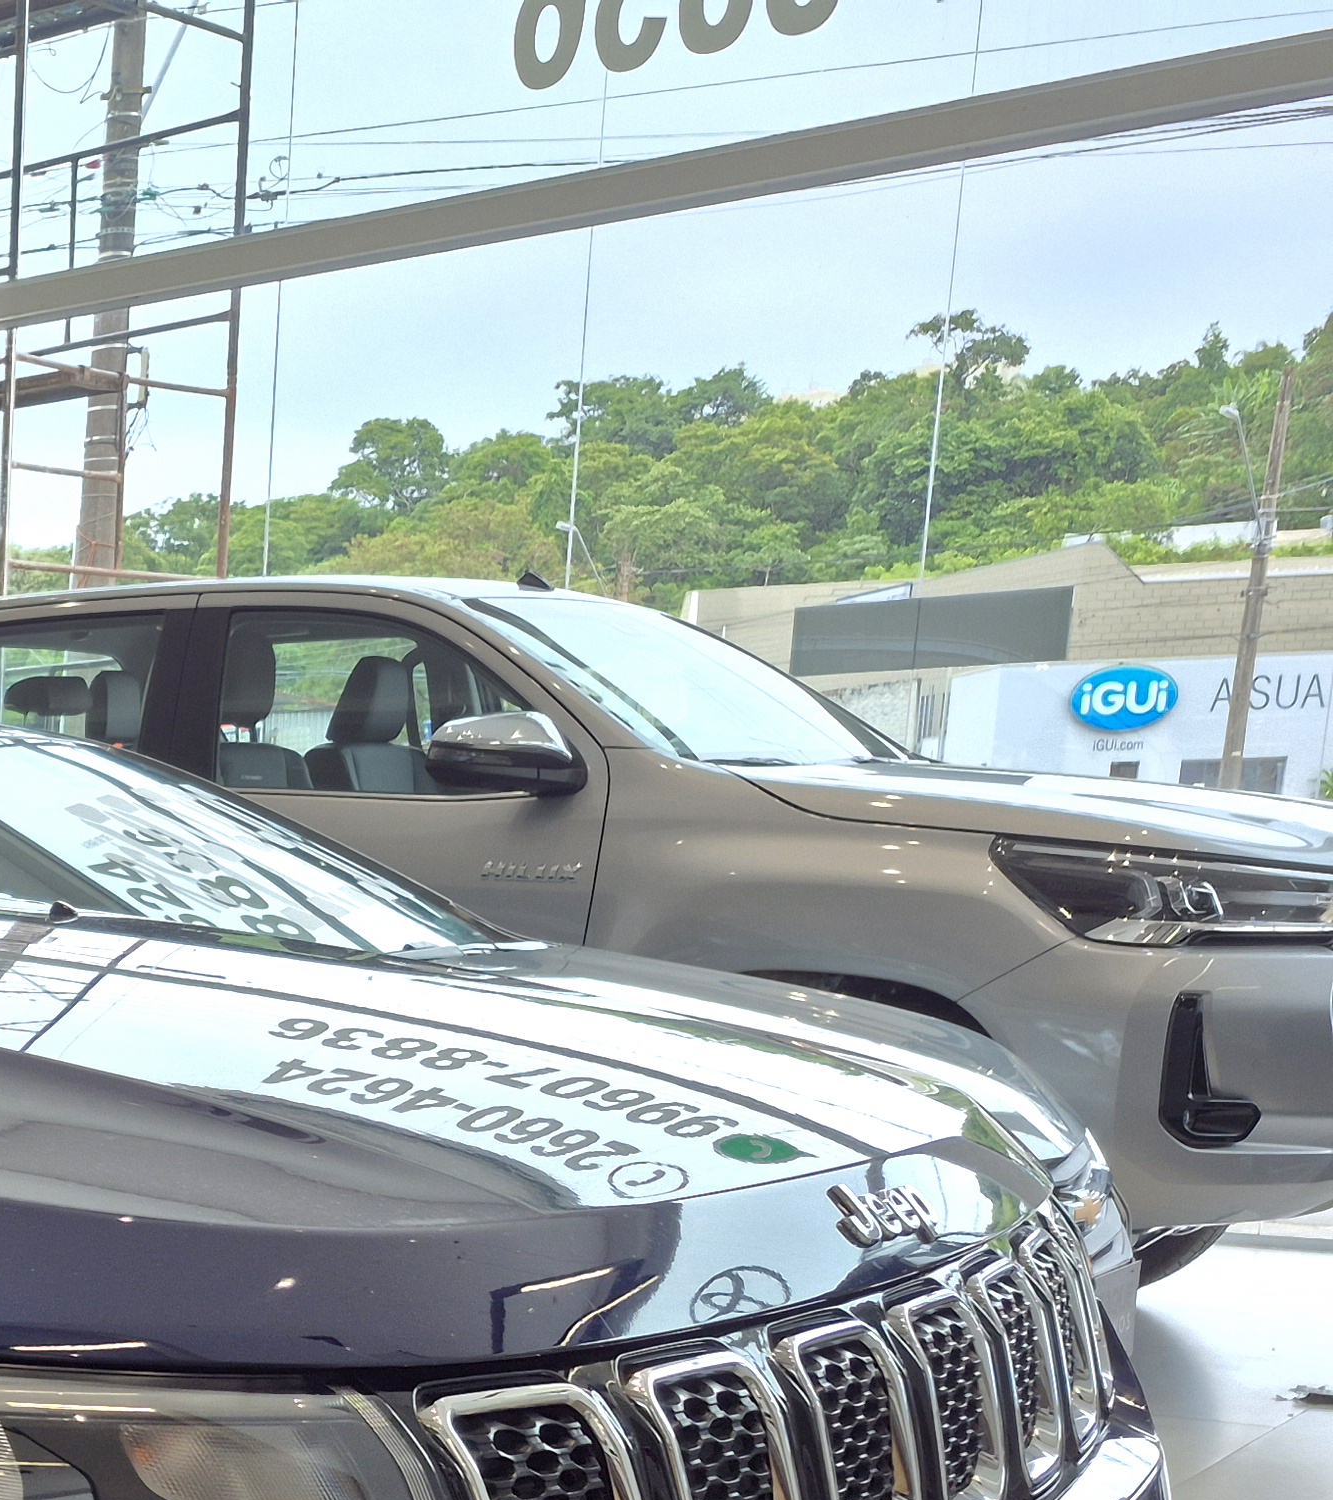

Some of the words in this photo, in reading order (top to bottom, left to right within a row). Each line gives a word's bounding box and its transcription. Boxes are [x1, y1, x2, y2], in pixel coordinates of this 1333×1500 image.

[1080, 679, 1170, 716] iGUi
[1249, 673, 1326, 711] SUA
[480, 860, 583, 880] HILUX
[269, 1016, 739, 1142] 99607-8836
[261, 1058, 644, 1174] 2660-4624
[825, 1183, 939, 1249] Jeep
